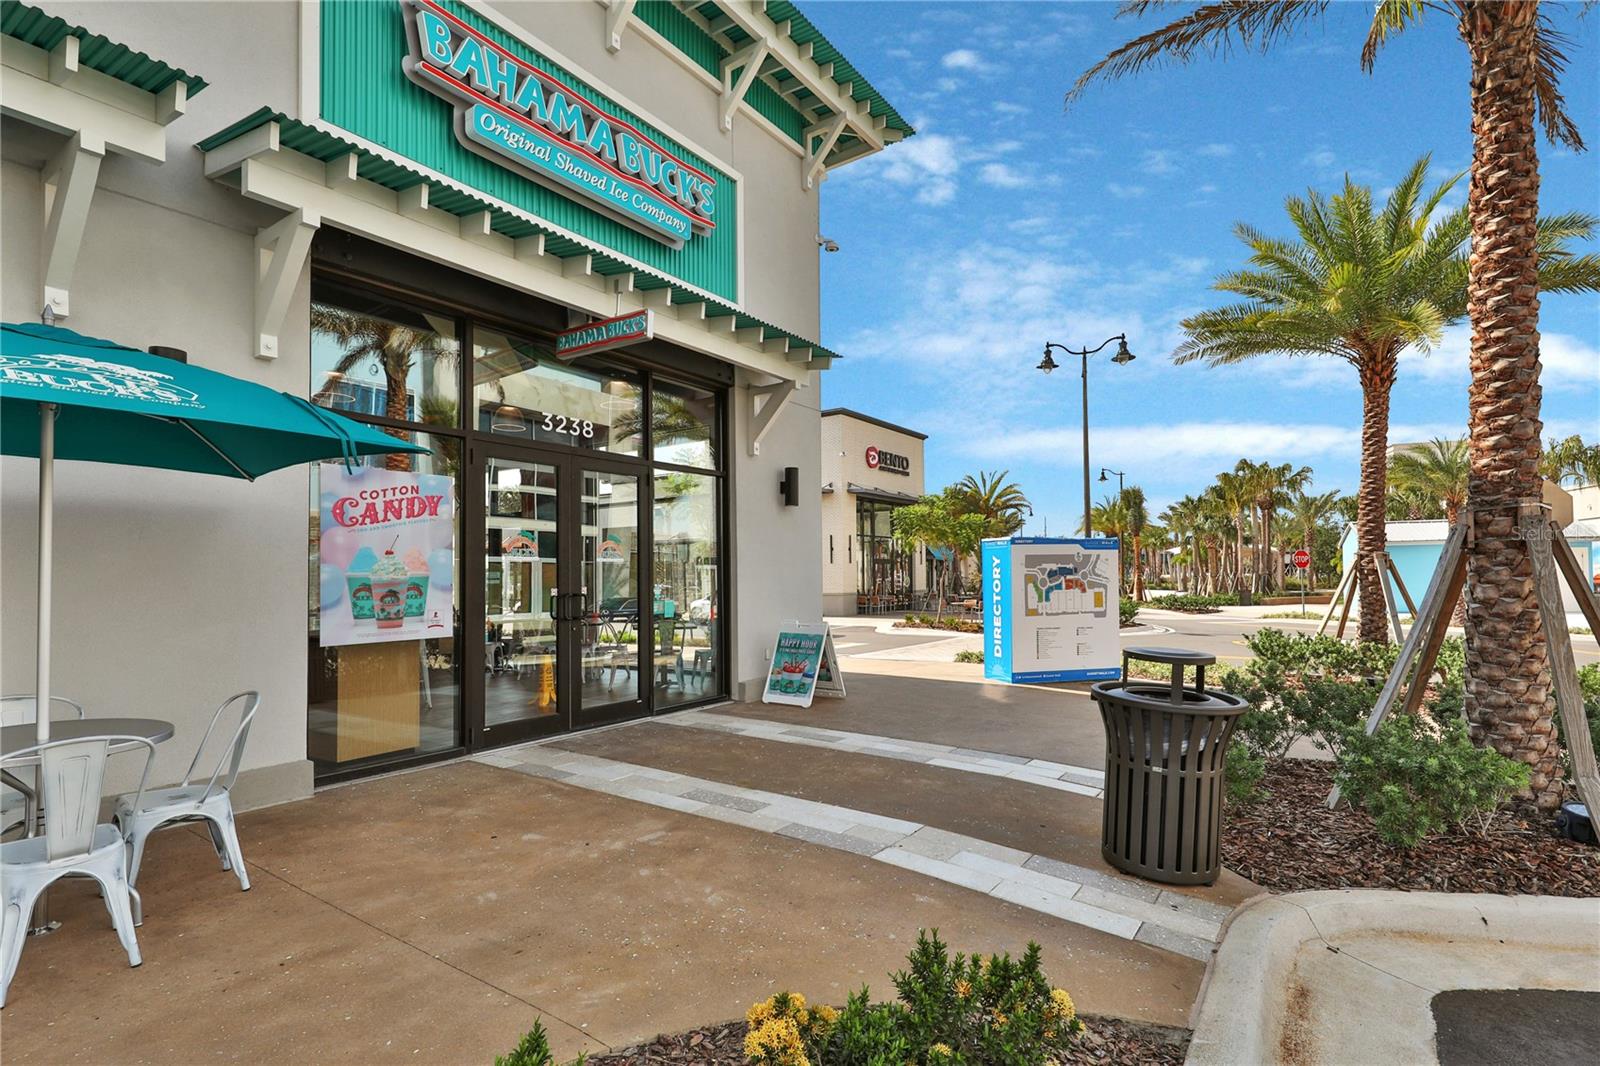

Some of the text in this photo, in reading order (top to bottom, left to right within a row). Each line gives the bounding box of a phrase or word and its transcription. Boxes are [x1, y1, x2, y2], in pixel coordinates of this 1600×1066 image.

[419, 9, 716, 216] BAHAMA BUCK'S
[480, 112, 687, 233] Original Shaved Ice Company
[559, 315, 646, 350] BAHAMA BUCK'S
[541, 411, 595, 438] 3238
[878, 450, 909, 470] BENTO
[359, 485, 420, 501] COTTON
[331, 495, 444, 528] CANDY
[1294, 555, 1309, 563] STOP
[991, 555, 1003, 659] DIRECTORY
[780, 637, 801, 648] HAPPY
